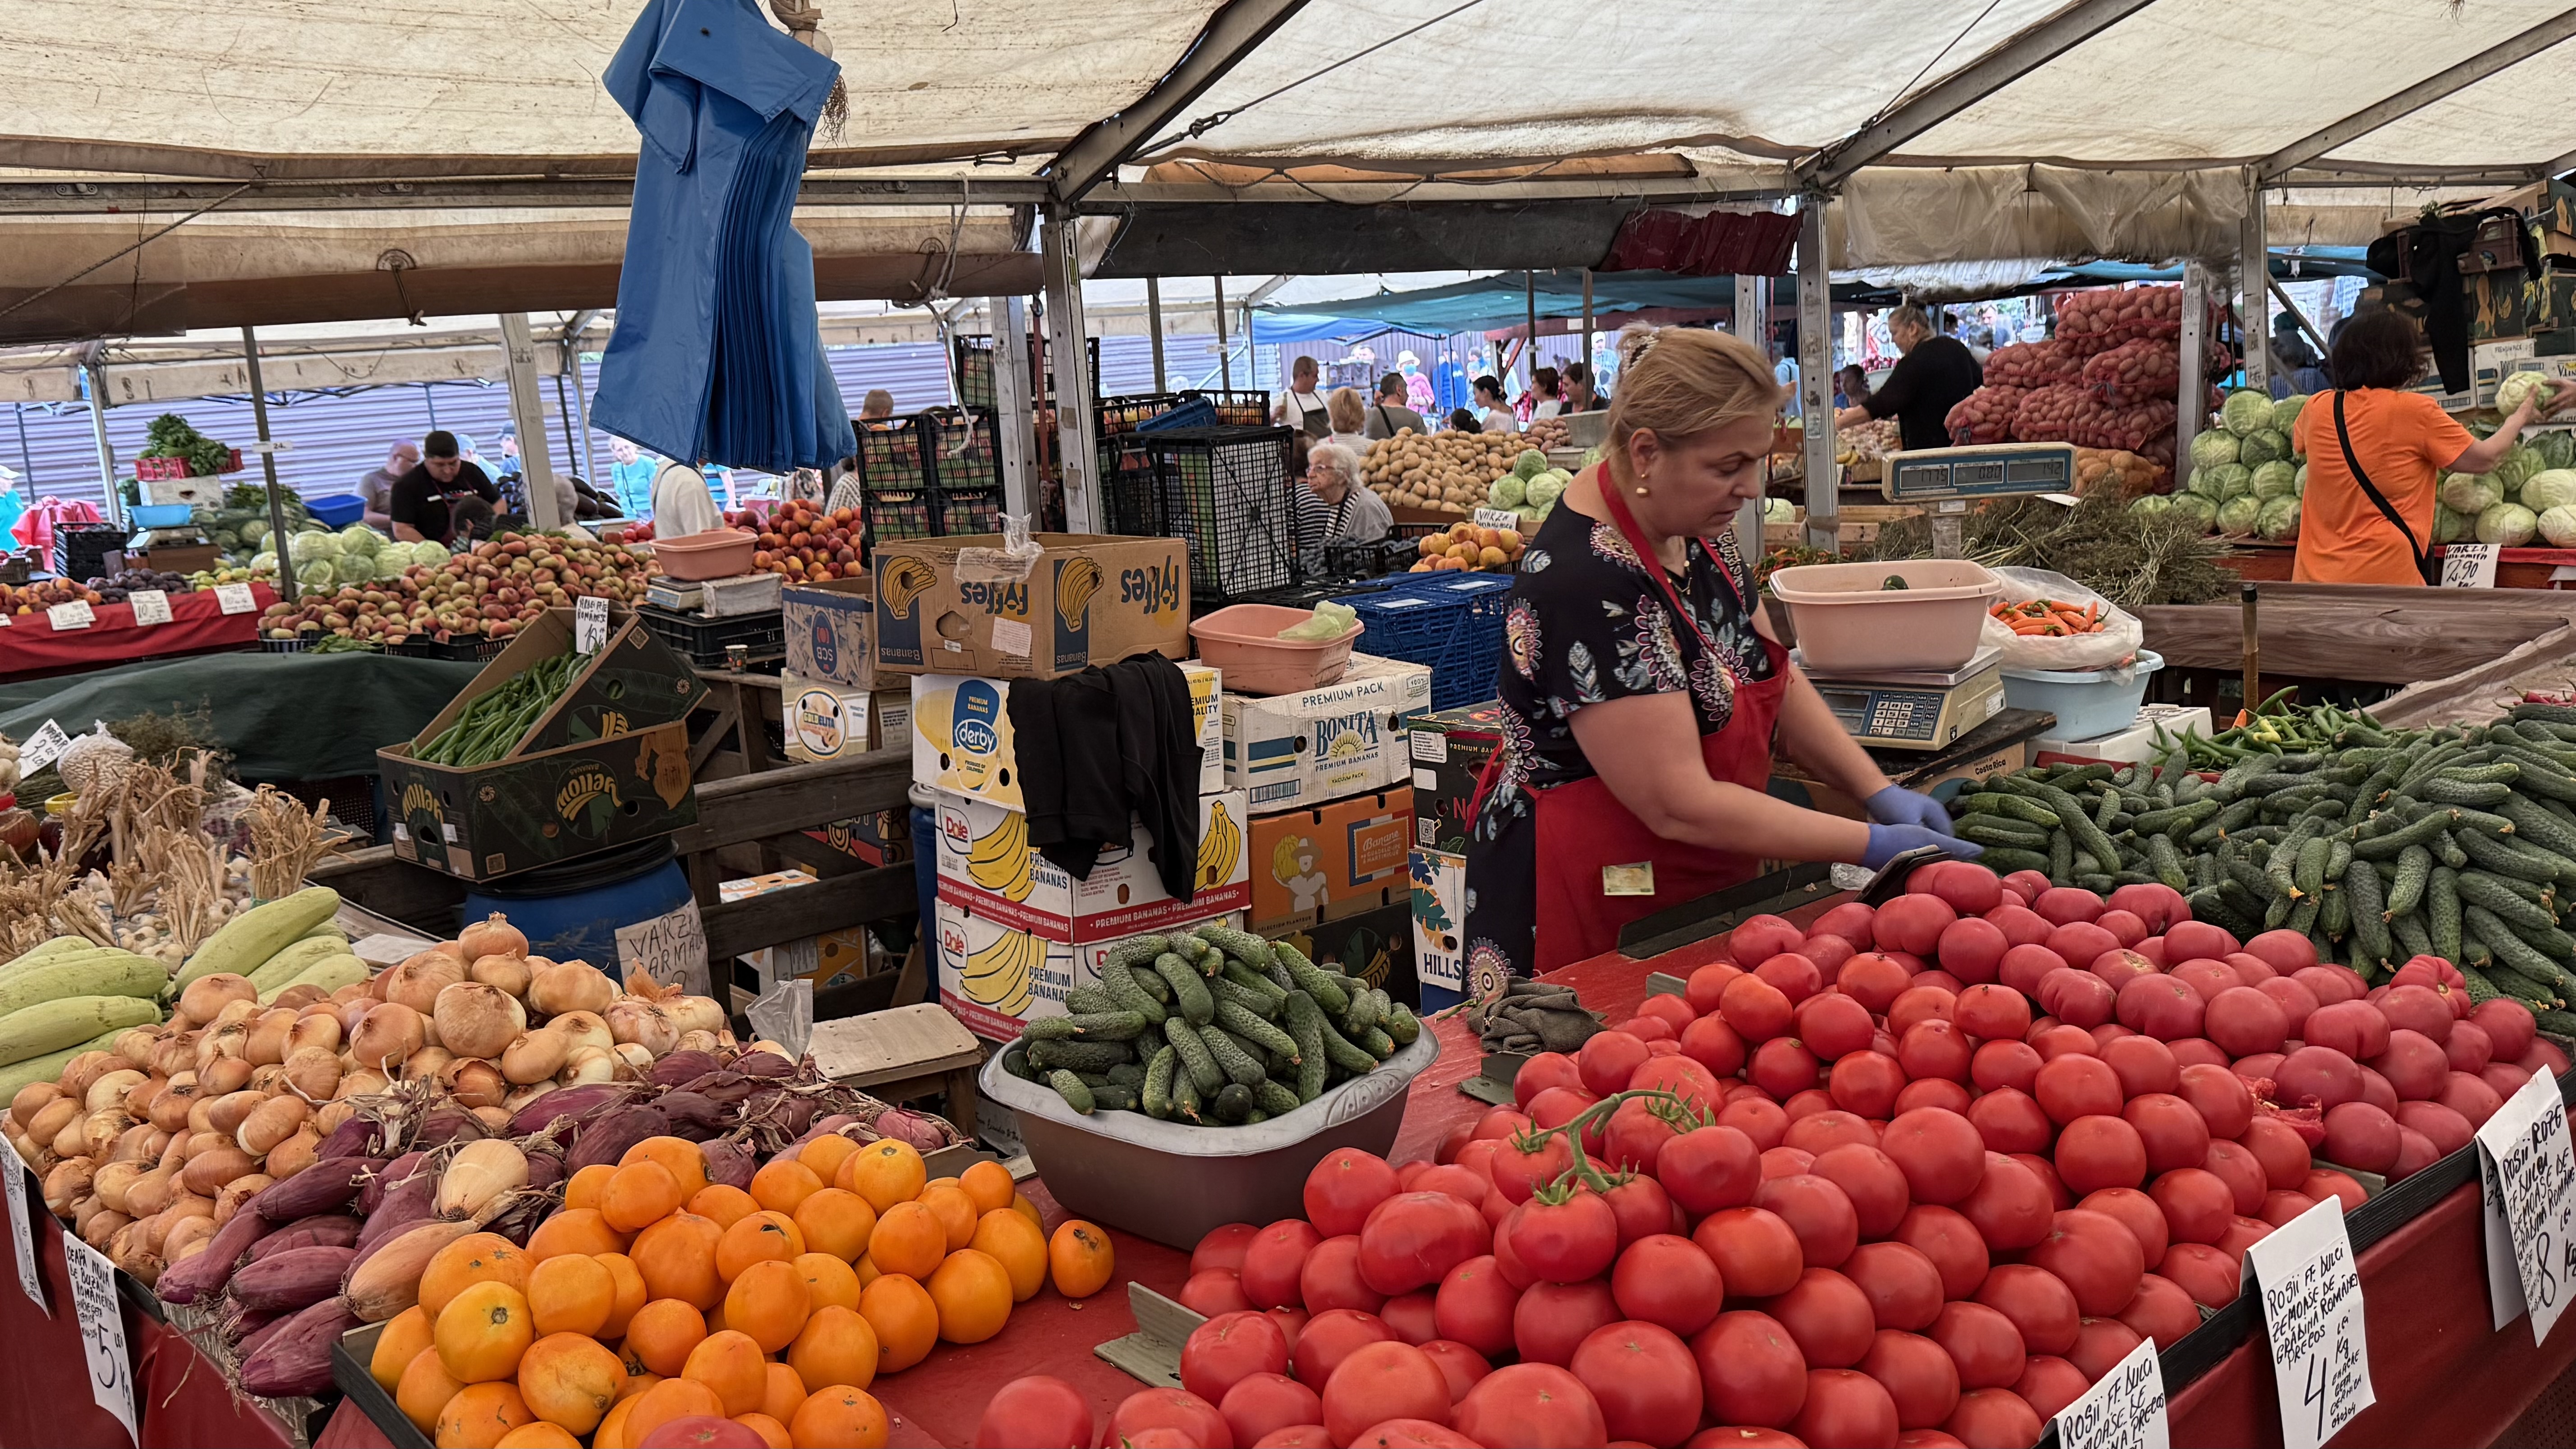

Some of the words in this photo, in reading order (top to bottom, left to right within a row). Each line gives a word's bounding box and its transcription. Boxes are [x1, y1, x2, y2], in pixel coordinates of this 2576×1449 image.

[817, 647, 833, 662] SCB
[881, 647, 920, 660] Bananas
[1057, 652, 1086, 664] Bananas
[1191, 694, 1218, 706] EMIUM
[1303, 690, 1353, 707] PREMIUM
[1357, 681, 1385, 698] PACK
[1194, 704, 1218, 716] ALITY
[959, 722, 995, 754] derby
[1315, 710, 1379, 757] BONITA
[1315, 759, 1346, 772] PREMIUM
[1348, 752, 1379, 764] BANANAS
[1975, 764, 1992, 775] Costa
[1993, 759, 2006, 769] Rica
[946, 815, 968, 839] Dole
[1030, 851, 1068, 874] PREMIU
[1030, 868, 1067, 889] BANANAS
[975, 894, 996, 910] PREMIUM
[996, 901, 1017, 917] BANANAS
[1020, 910, 1043, 925] PREMIUM
[1043, 917, 1069, 933] BANANAS
[1096, 912, 1132, 928] PREMIUM
[1133, 906, 1167, 920] BANANAS
[1173, 896, 1205, 912] PREMIUM
[1206, 890, 1237, 905] BANANAS
[945, 930, 965, 955] Dole
[1029, 966, 1070, 988] PREMIUM
[1424, 953, 1462, 980] HILLS
[968, 1009, 991, 1025] PREMIUM
[991, 1016, 1012, 1032] BANANAS
[2556, 1146, 2569, 1177] DE
[2536, 1232, 2556, 1308] 8
[2323, 1274, 2335, 1297] DE
[97, 1322, 116, 1389] 5
[2304, 1352, 2327, 1442] 4
